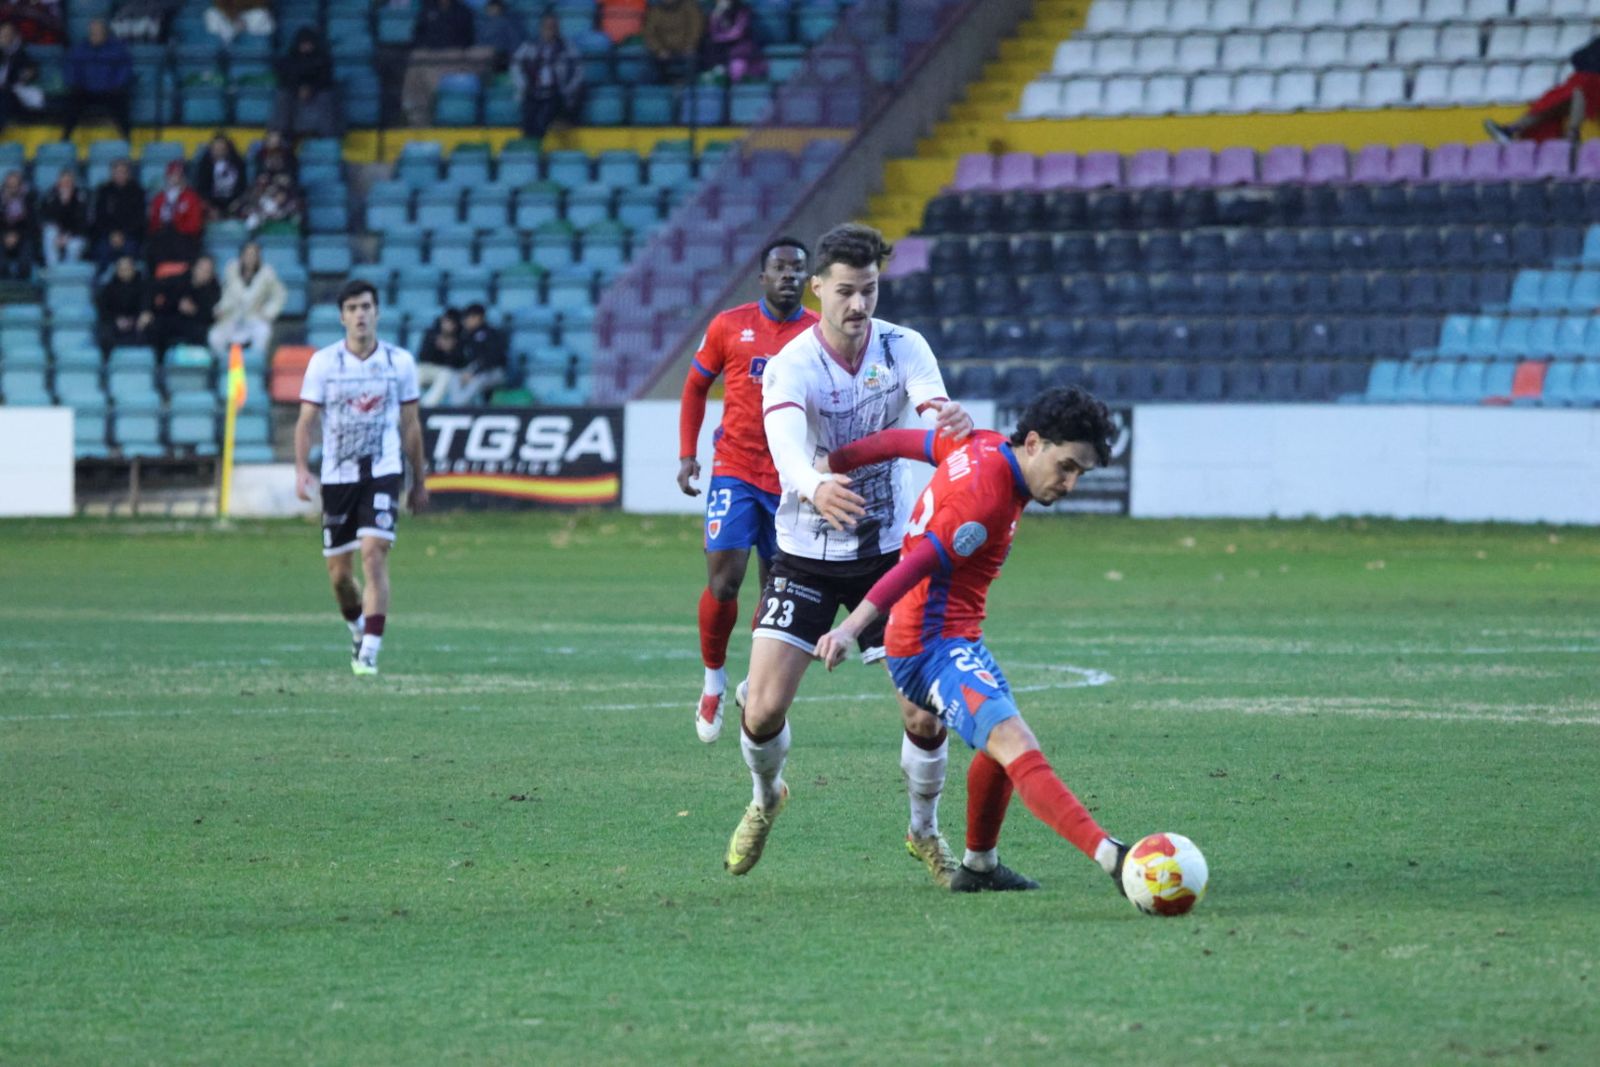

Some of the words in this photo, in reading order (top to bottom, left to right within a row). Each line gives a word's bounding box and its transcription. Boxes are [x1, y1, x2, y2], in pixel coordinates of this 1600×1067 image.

[426, 414, 617, 463] TGSA
[707, 488, 732, 518] 23
[760, 597, 795, 628] 23
